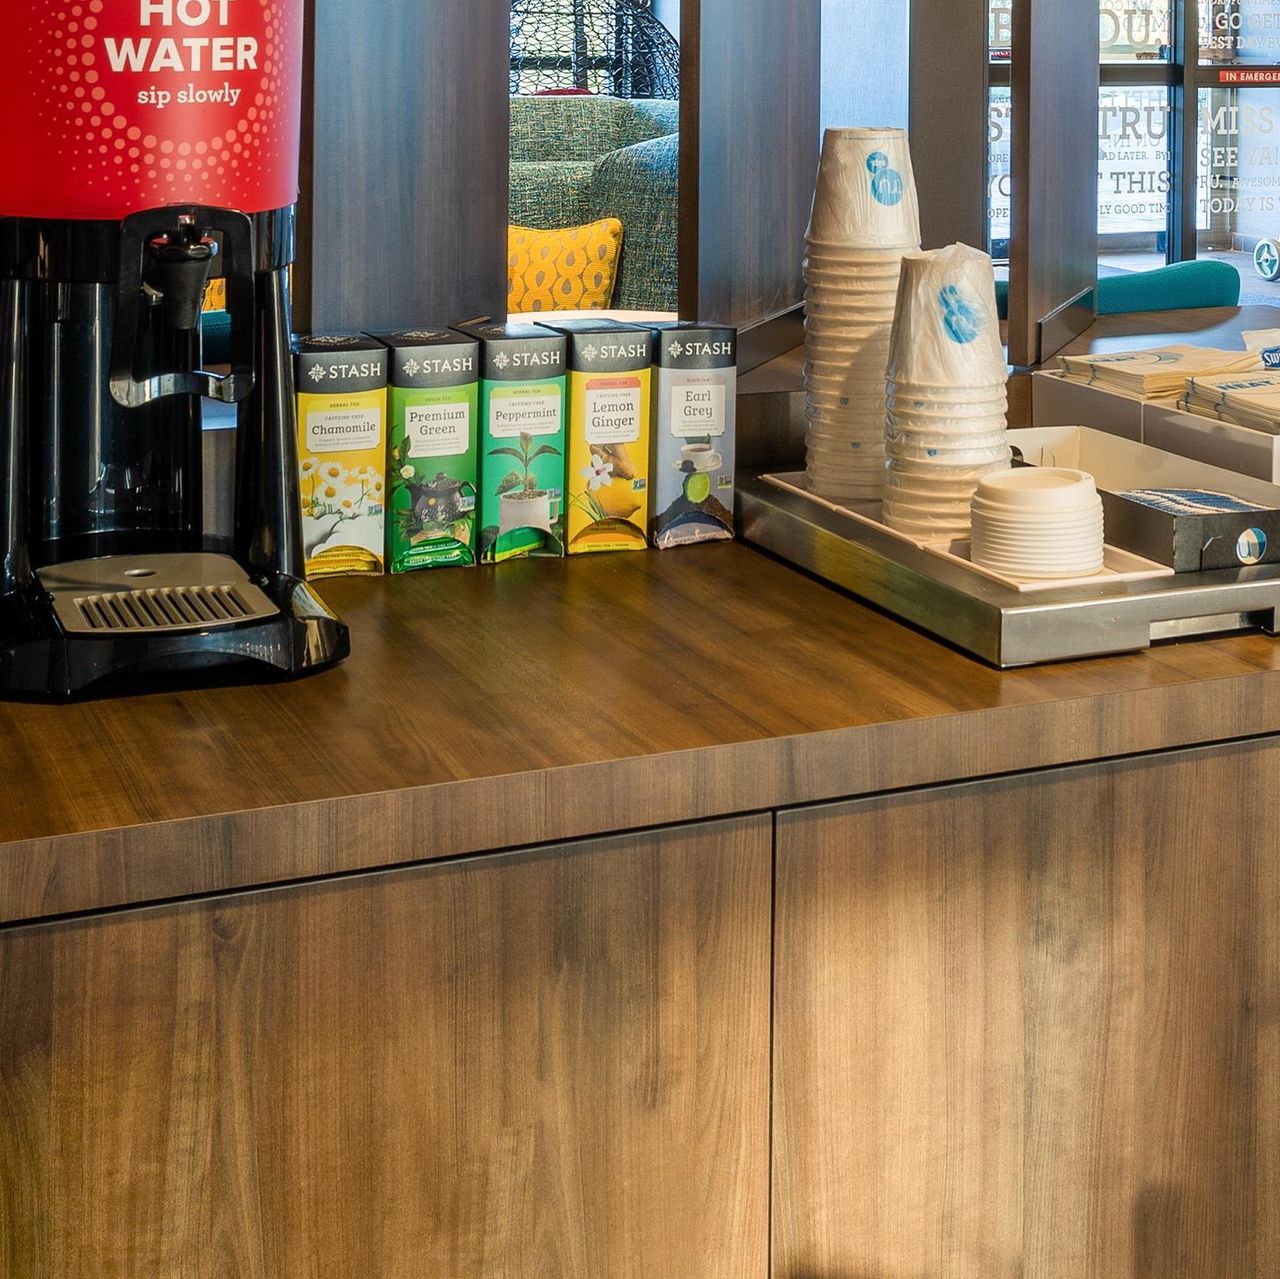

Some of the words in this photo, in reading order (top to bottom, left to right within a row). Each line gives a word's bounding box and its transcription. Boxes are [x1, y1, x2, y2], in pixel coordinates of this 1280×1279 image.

[1099, 8, 1162, 49] OU.
[1215, 12, 1244, 30] GO
[103, 36, 258, 72] WATER
[1225, 72, 1237, 81] IN
[137, 85, 170, 108] sip
[176, 82, 241, 106] slowly
[1200, 106, 1274, 135] MISS
[1102, 151, 1116, 161] AD
[1118, 151, 1150, 161] LATER.
[1200, 146, 1239, 168] SEE
[1110, 170, 1172, 194] THIS
[1114, 203, 1146, 215] GOOD
[1259, 196, 1274, 211] IS
[600, 344, 647, 359] STASH
[685, 341, 731, 356] STASH
[423, 357, 473, 373] STASH
[512, 351, 561, 367] STASH
[329, 362, 381, 380] STASH
[685, 390, 711, 401] Earl
[495, 408, 556, 421] Peppermint
[593, 402, 634, 413] Lemon
[683, 405, 713, 419] Grey
[409, 409, 465, 422] Premium
[592, 415, 634, 429] Ginger
[312, 422, 376, 436] Chamomile
[420, 425, 456, 436] Green
